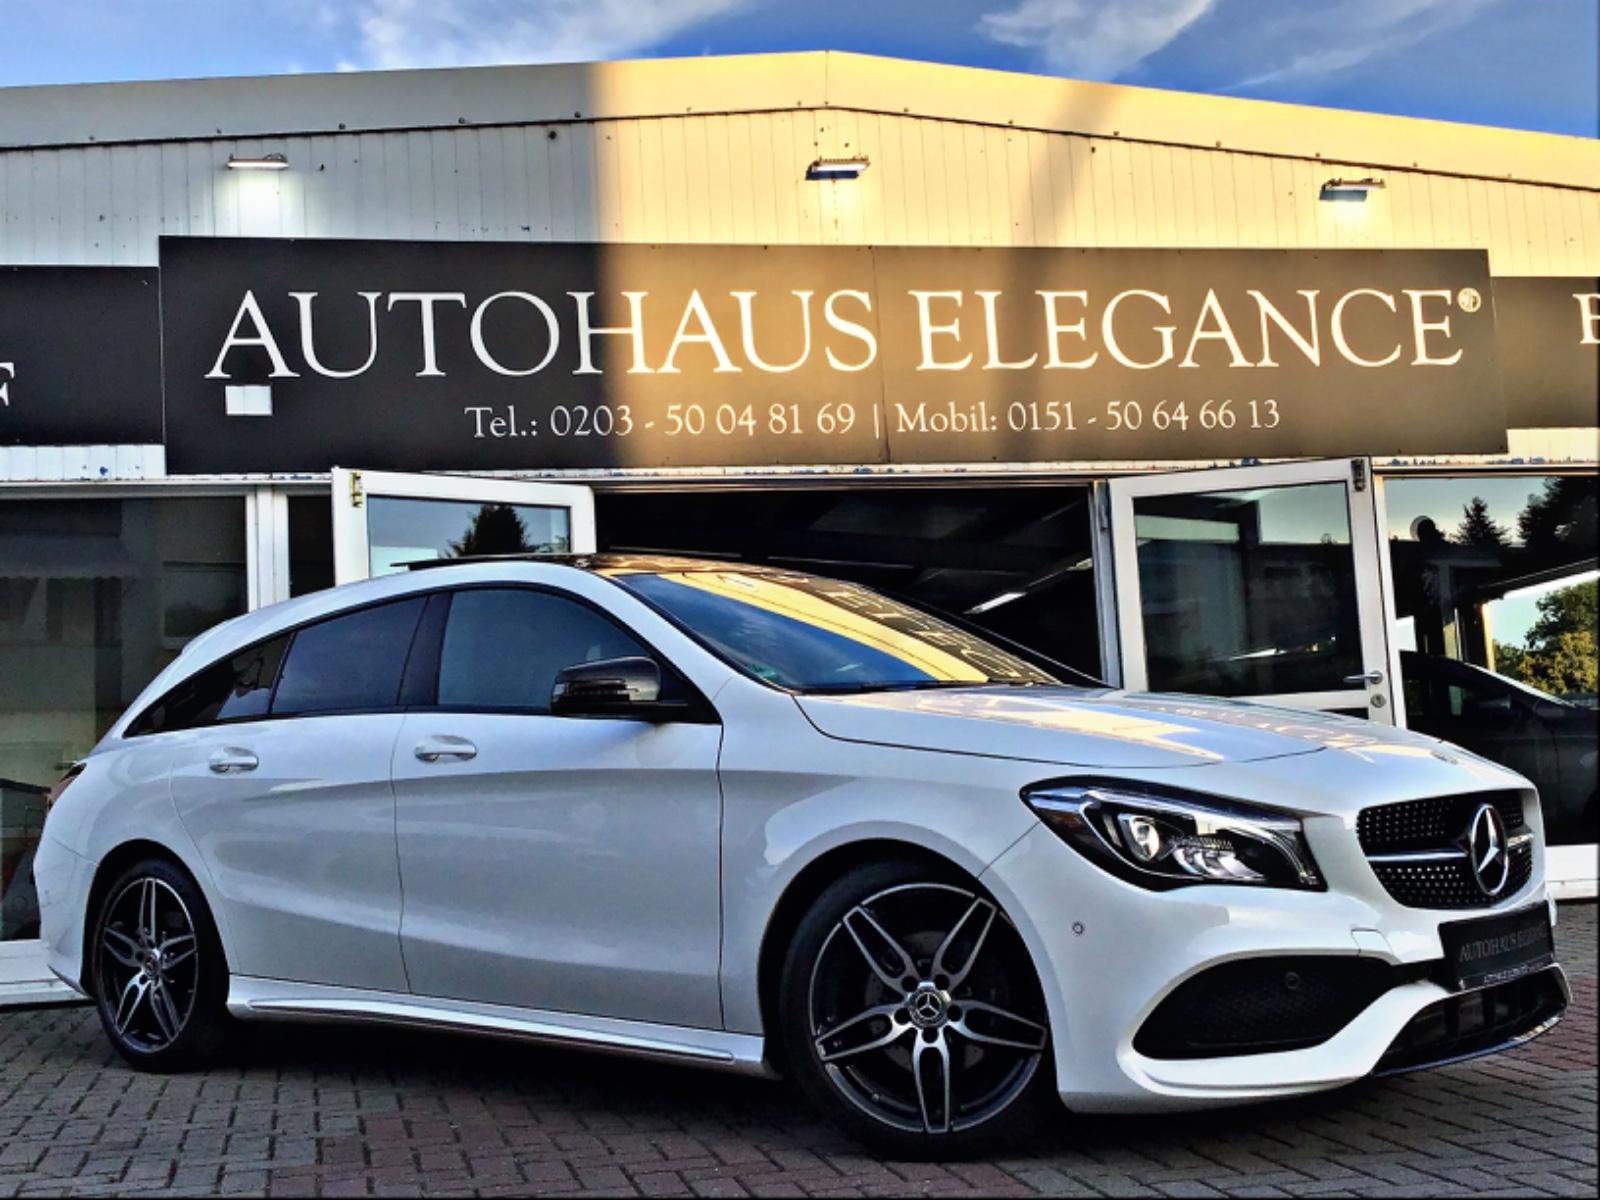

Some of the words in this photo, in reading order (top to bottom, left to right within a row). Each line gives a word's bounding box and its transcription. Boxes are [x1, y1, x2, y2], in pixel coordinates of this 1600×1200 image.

[205, 289, 878, 378] AUTOHAUS
[907, 289, 1463, 371] ELEGANCE
[464, 404, 538, 438] Tel.:
[550, 404, 633, 436] 0203
[664, 403, 705, 435] 50
[715, 403, 757, 436] 04
[768, 403, 803, 434] 81
[816, 402, 856, 434] 69
[895, 400, 998, 432] Mobil:
[1007, 400, 1077, 432] 0151
[1105, 400, 1142, 431] 50
[1152, 400, 1189, 431] 64
[1199, 399, 1236, 429] 66
[1248, 399, 1280, 429] 13
